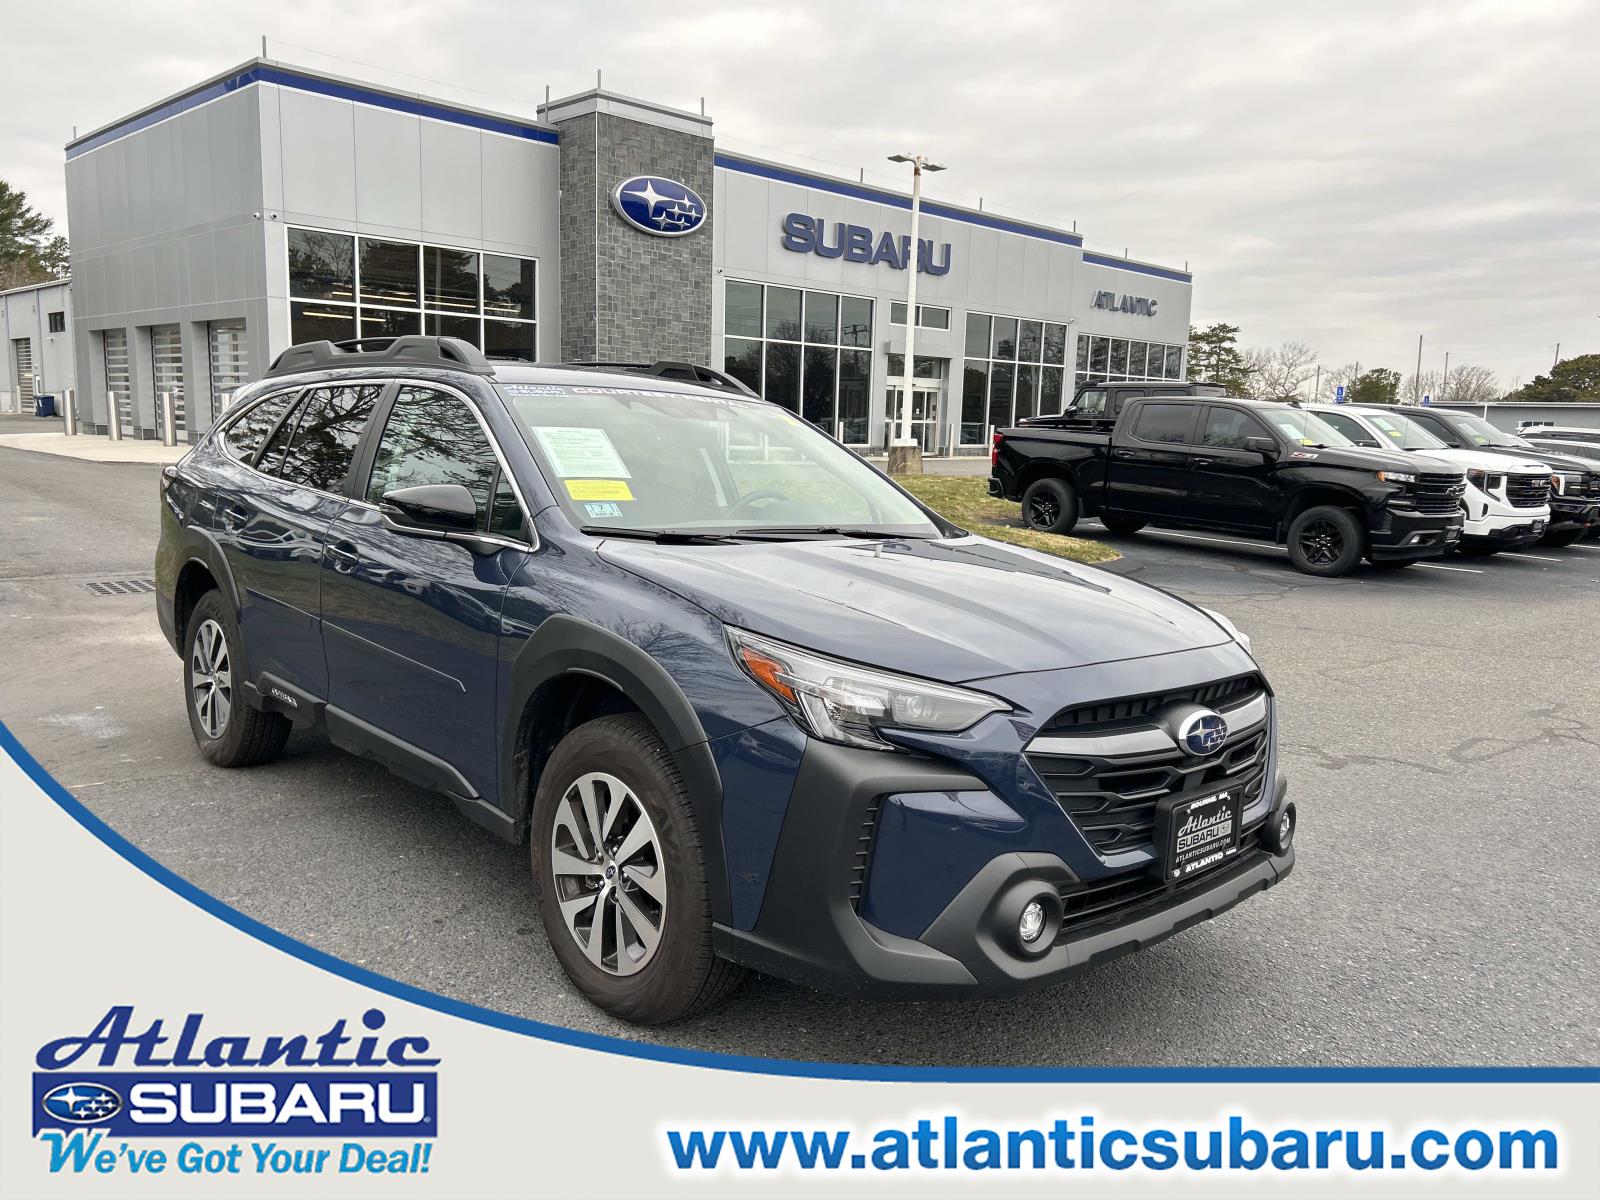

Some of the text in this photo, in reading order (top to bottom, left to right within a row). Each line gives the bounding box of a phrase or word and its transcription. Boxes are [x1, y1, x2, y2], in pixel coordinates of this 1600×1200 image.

[783, 212, 952, 276] SUBARU
[1091, 290, 1158, 317] ATLANTIC
[1177, 805, 1233, 837] Atlantic
[1178, 828, 1219, 850] SUBARU
